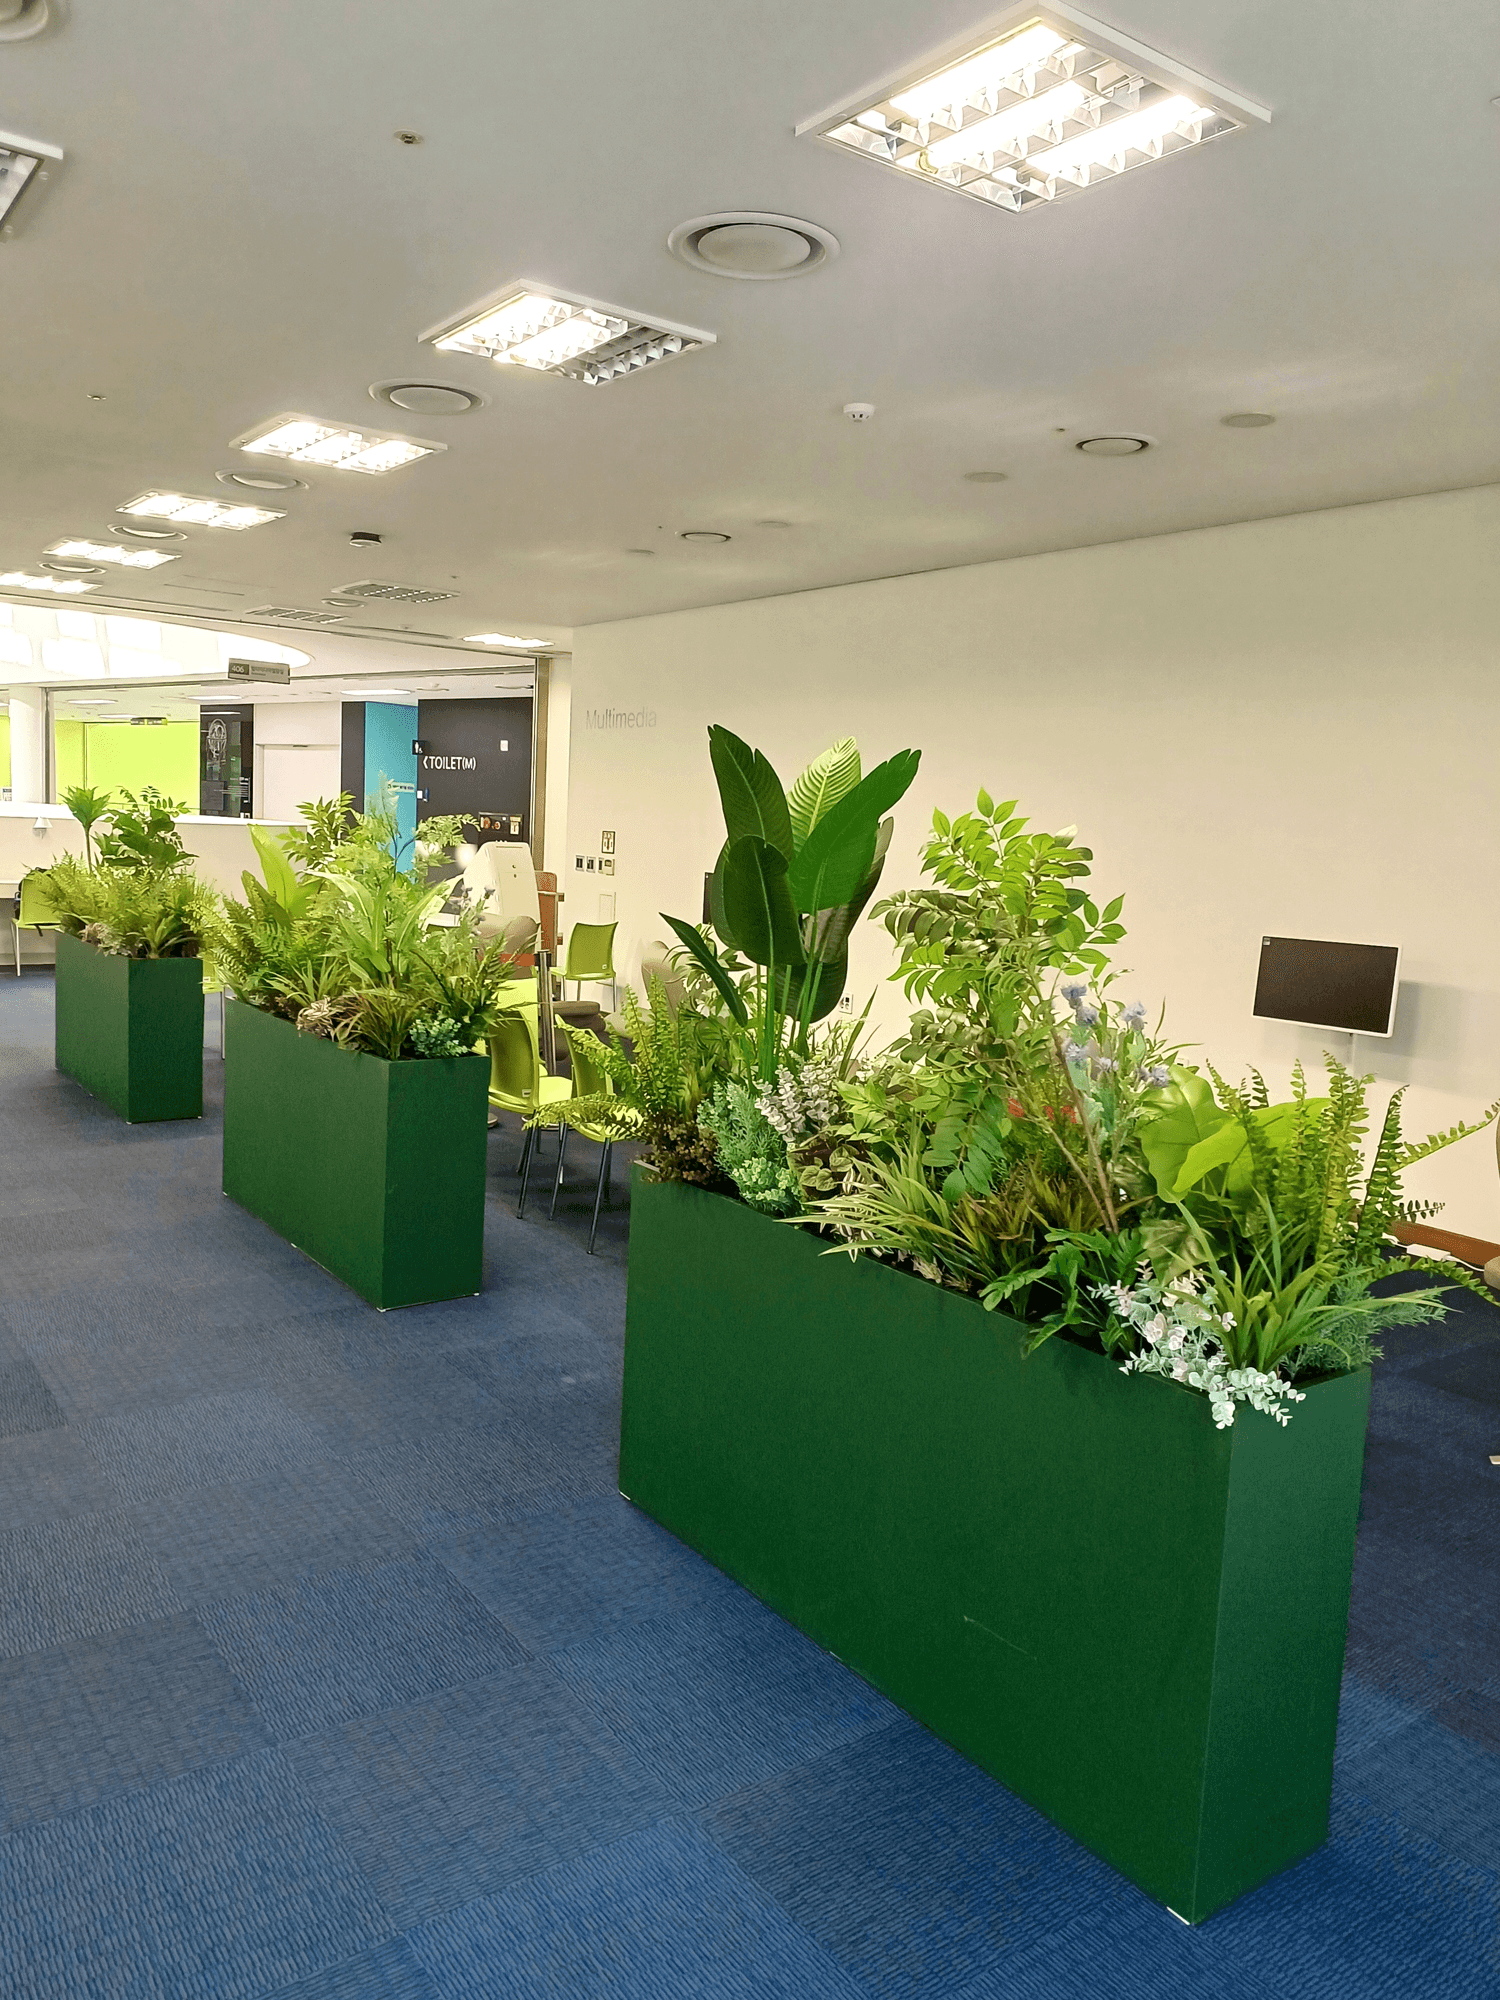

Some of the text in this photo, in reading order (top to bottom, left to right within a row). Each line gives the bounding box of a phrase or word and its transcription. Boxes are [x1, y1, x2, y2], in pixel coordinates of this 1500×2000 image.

[231, 665, 245, 673] 406
[585, 706, 657, 730] Multimedia
[428, 756, 477, 770] TOILET(M)
